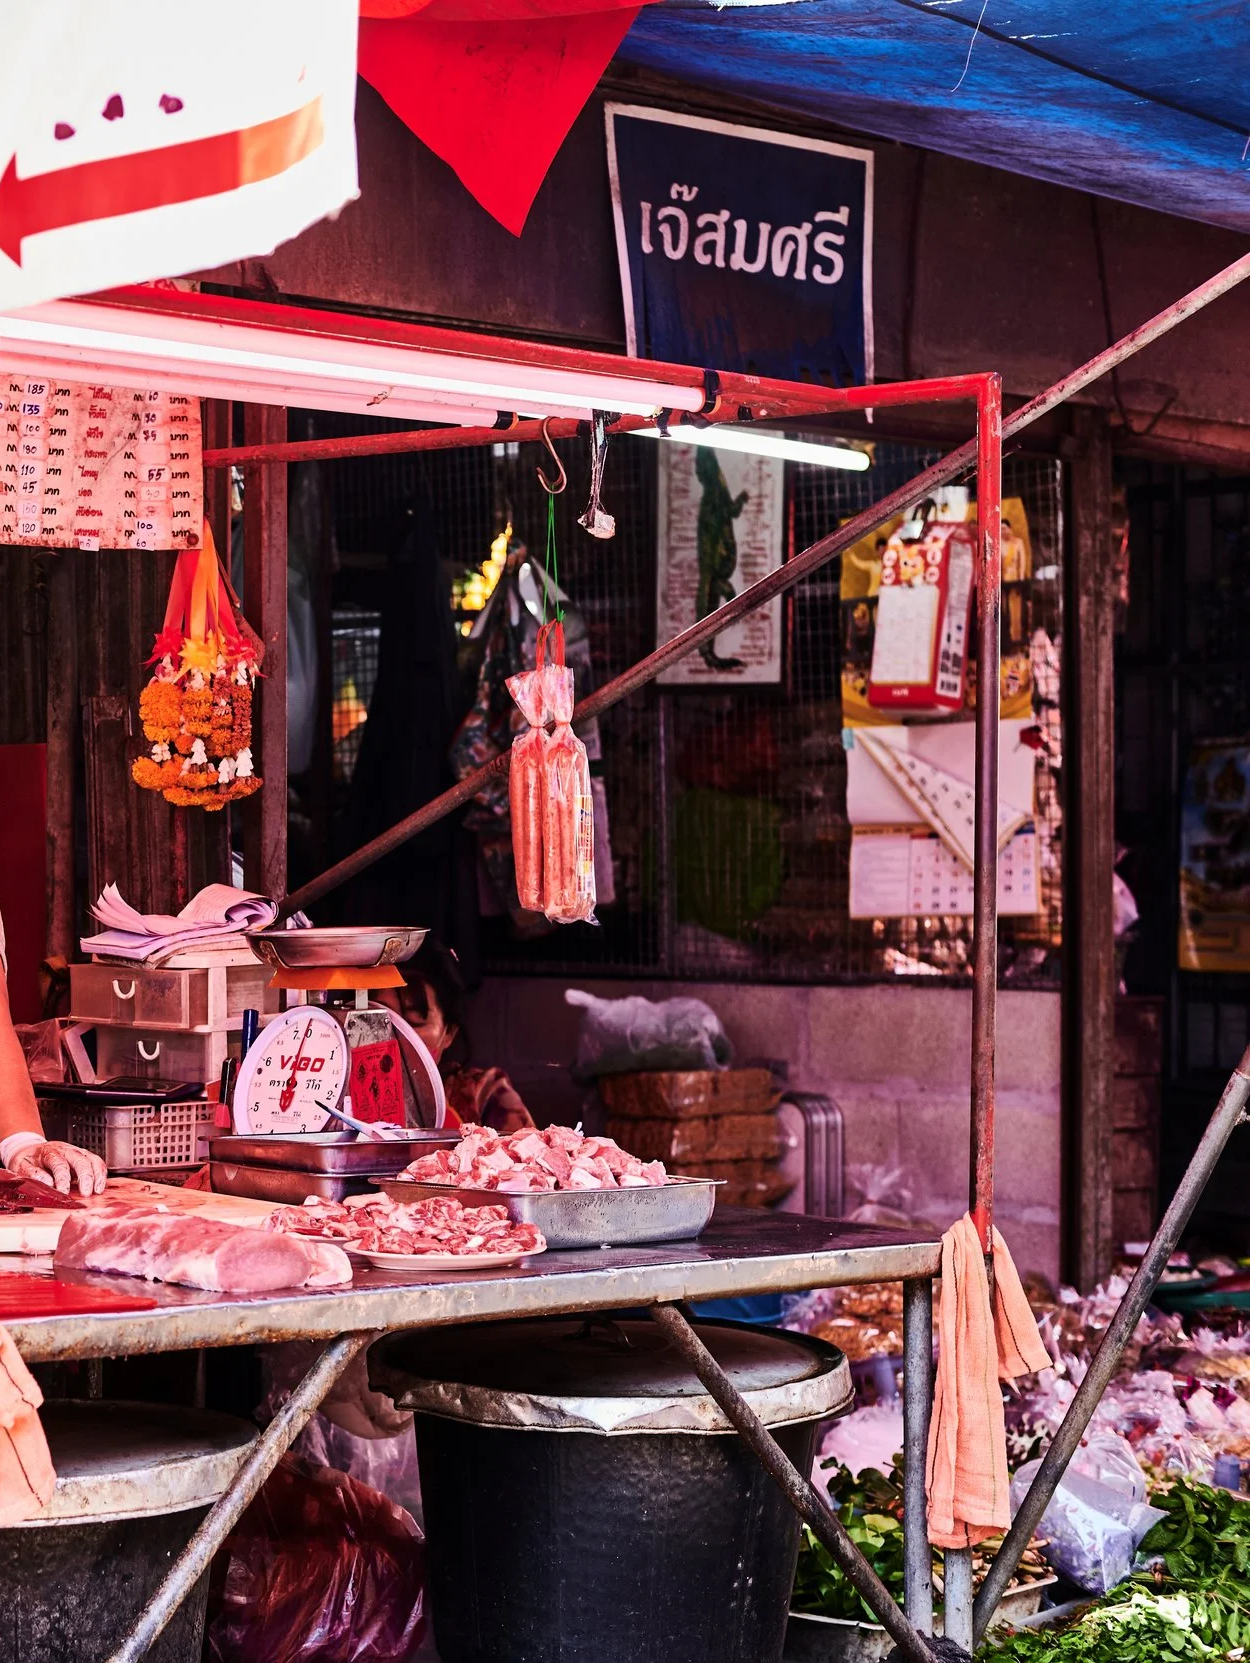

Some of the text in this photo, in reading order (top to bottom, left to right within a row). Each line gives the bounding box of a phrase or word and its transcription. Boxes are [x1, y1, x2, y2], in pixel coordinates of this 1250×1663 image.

[640, 182, 851, 285] เจ๊สมศรี
[27, 383, 46, 395] 185
[22, 403, 41, 416] 135
[25, 424, 41, 433] 100
[20, 464, 36, 476] 110
[21, 522, 37, 534] 120
[136, 520, 154, 530] 100
[293, 1029, 300, 1041] 7
[265, 1056, 273, 1067] 6
[329, 1050, 336, 1061] 1
[326, 1090, 334, 1101] 2
[253, 1101, 261, 1113] 5
